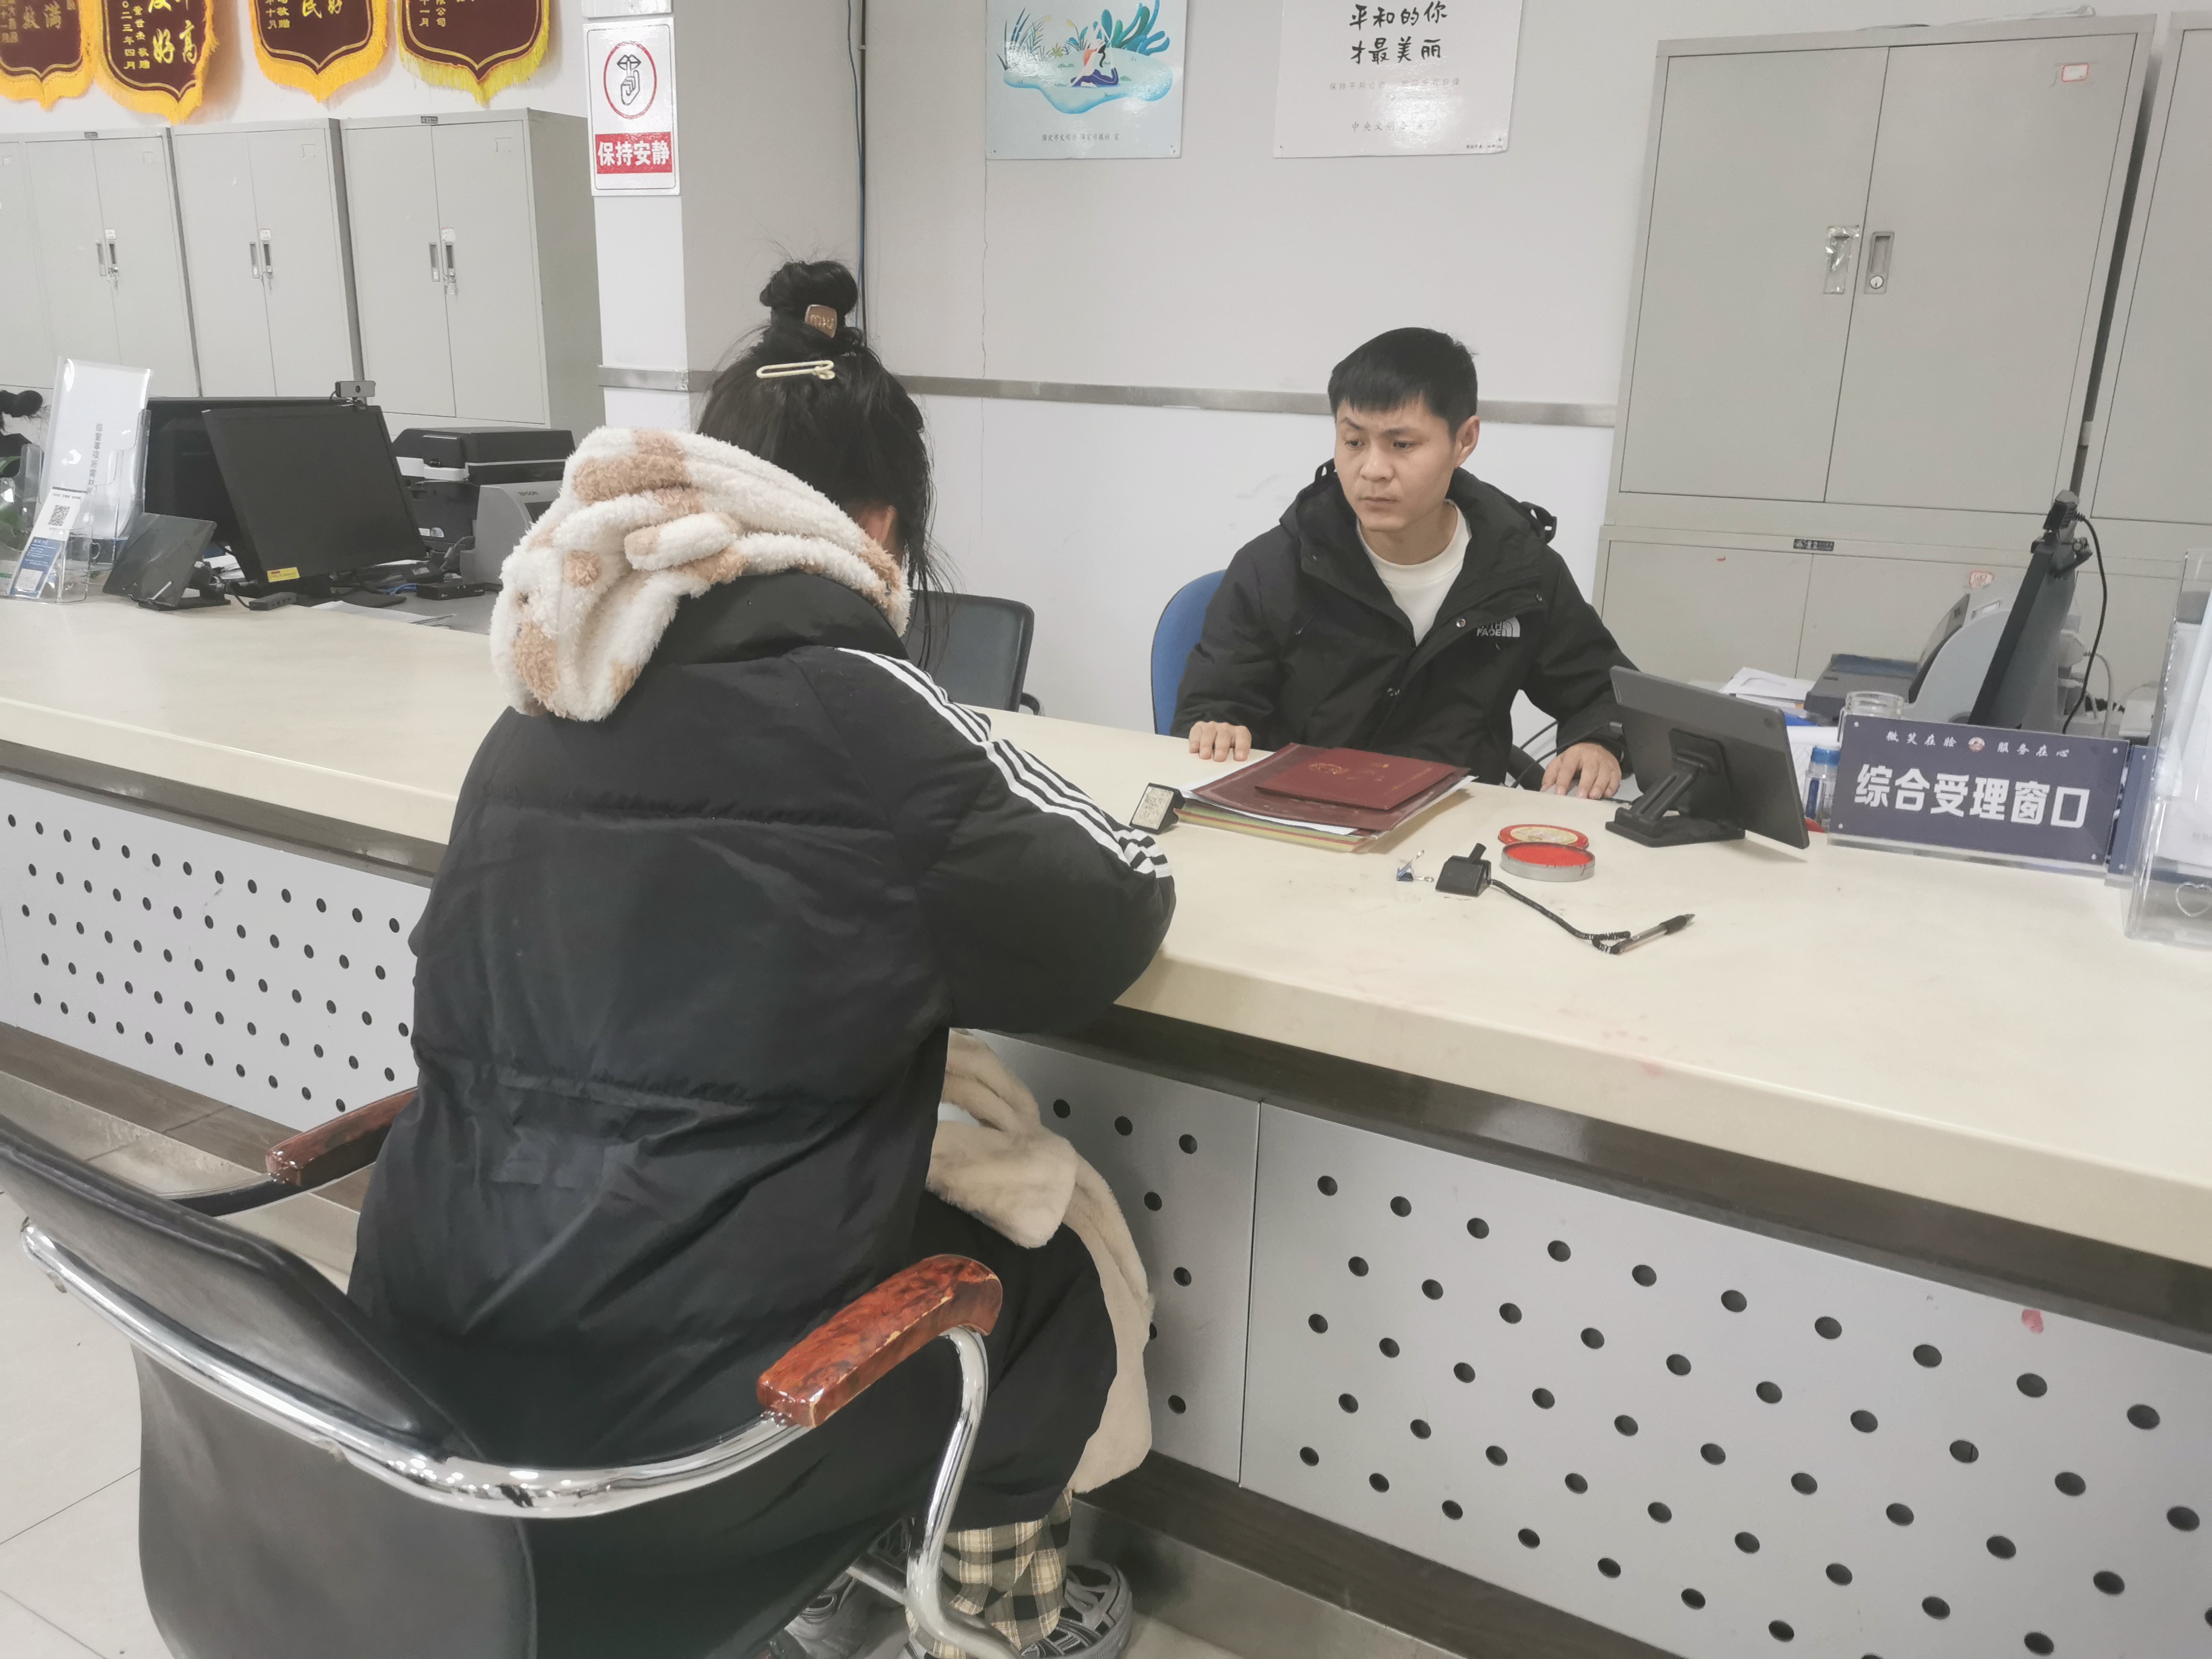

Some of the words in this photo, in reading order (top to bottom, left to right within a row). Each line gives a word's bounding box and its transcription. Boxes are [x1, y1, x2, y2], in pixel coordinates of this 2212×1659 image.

[276, 0, 290, 28] 敬赠
[1349, 1, 1448, 31] 平和的你
[1350, 36, 1441, 65] 才最美丽
[598, 139, 670, 167] 保持安静
[1886, 729, 1957, 748] 微笑在脸
[1997, 742, 2070, 758] 服务在心
[1854, 763, 2090, 829] 综合受理窗口
